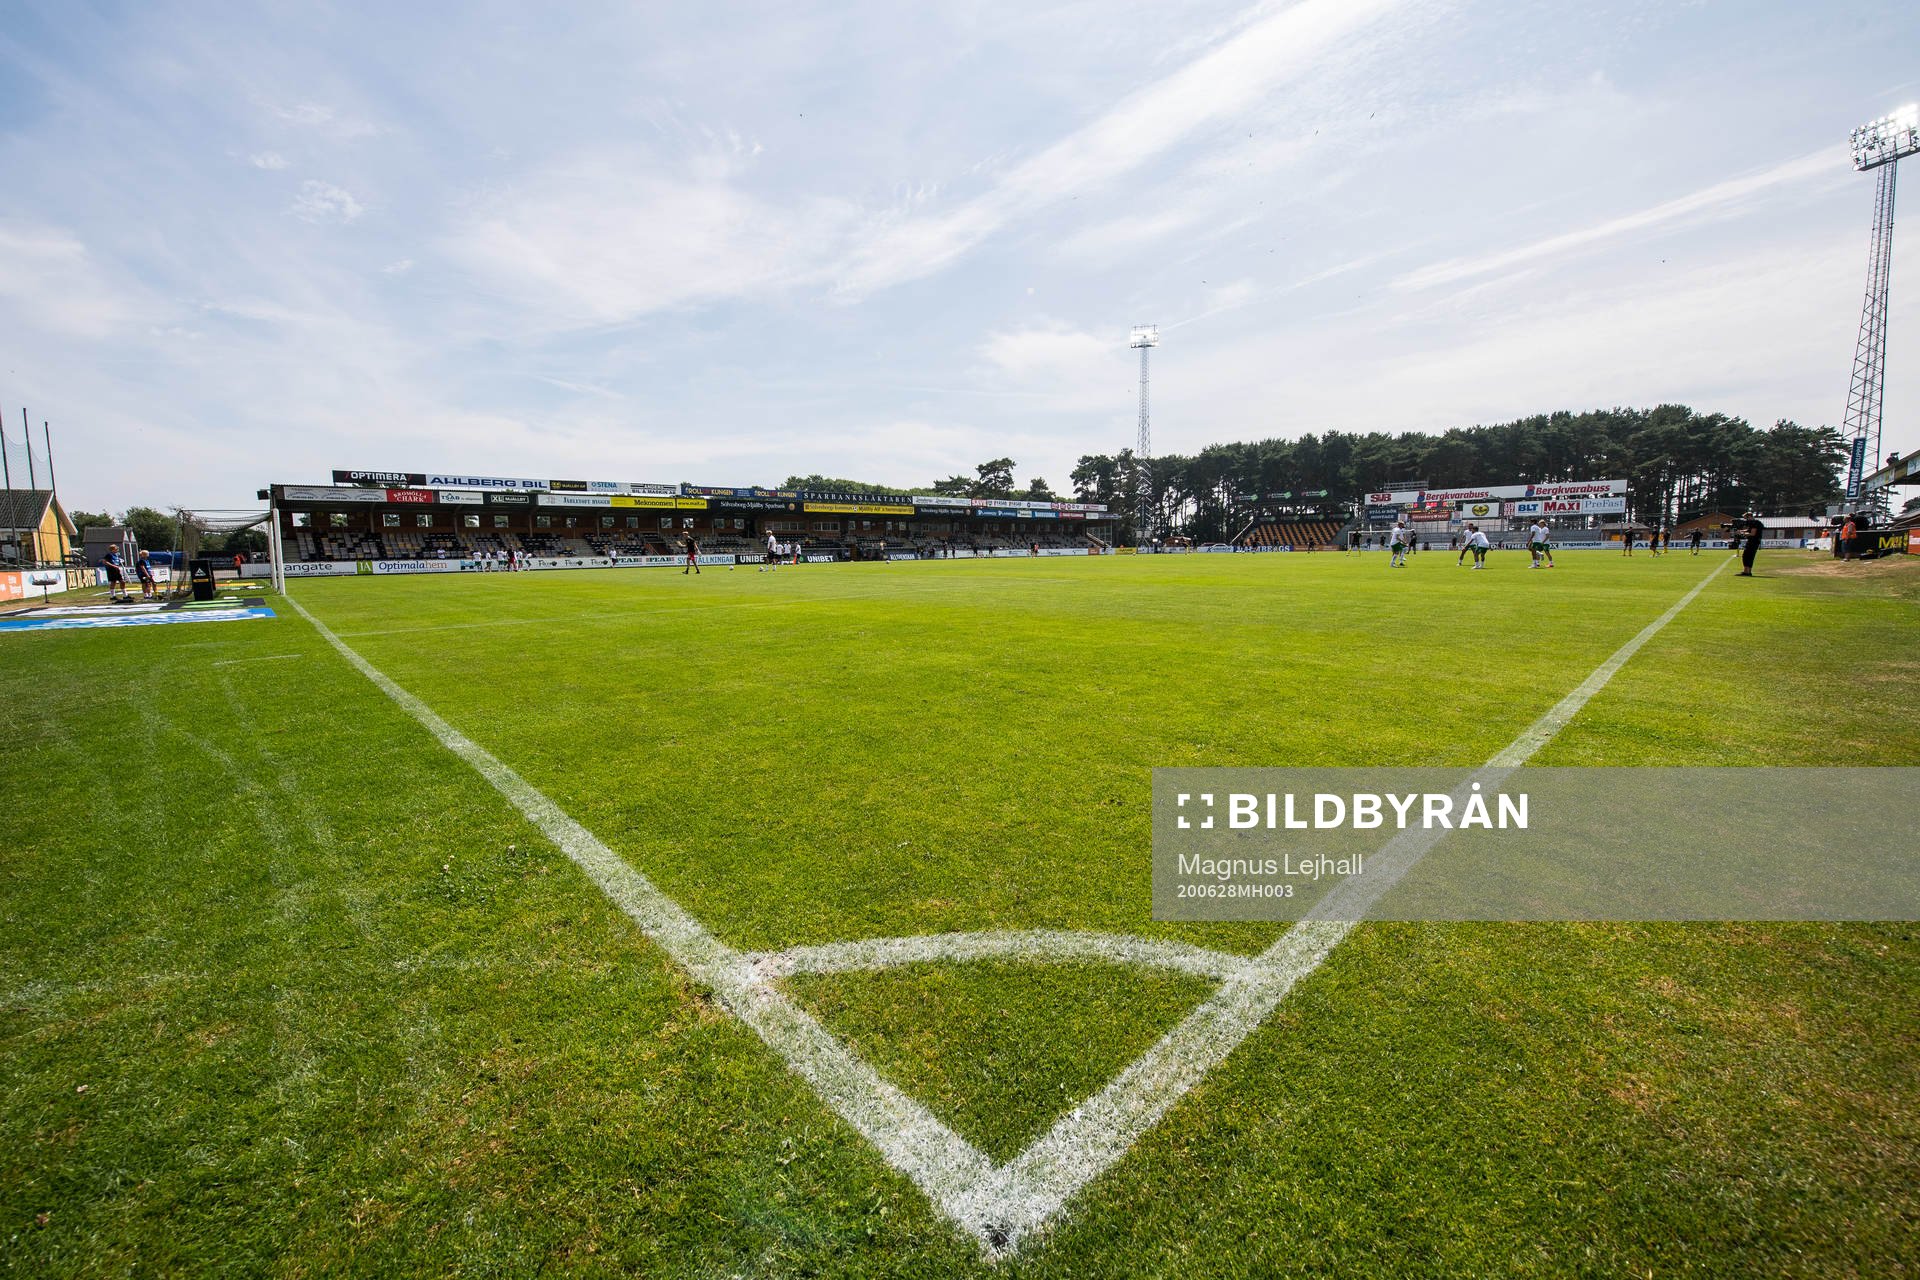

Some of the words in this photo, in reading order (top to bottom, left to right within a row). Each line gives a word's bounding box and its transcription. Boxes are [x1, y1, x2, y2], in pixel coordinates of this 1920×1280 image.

[350, 471, 407, 481] OPTIMERA
[430, 477, 517, 487] AHLBERG
[1426, 490, 1489, 501] Bergkvarabuss
[1535, 484, 1611, 497] Bergkvarabuss
[634, 499, 673, 507] Mekonomen
[1518, 503, 1539, 511] BLT
[1543, 501, 1580, 511] MAXI
[1584, 499, 1623, 508] PreFast
[740, 554, 768, 563] UNIBE
[807, 555, 833, 563] UNIBET
[378, 560, 448, 572] Optimalahem
